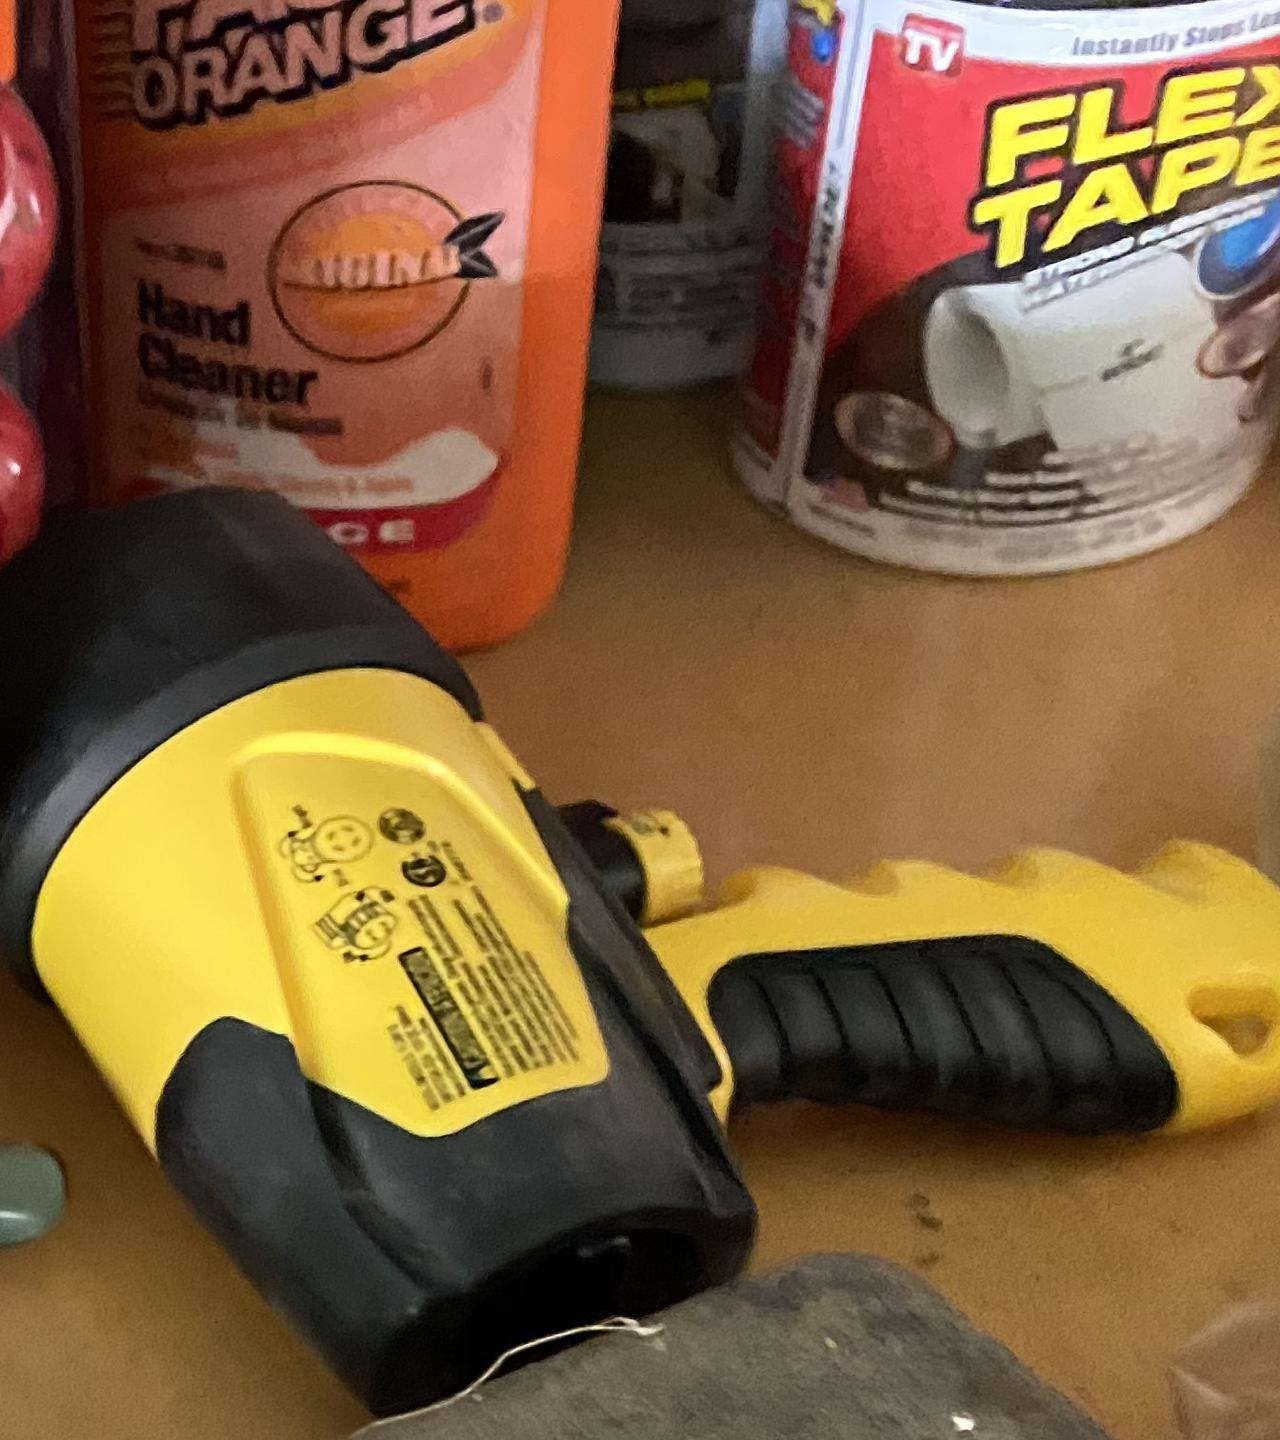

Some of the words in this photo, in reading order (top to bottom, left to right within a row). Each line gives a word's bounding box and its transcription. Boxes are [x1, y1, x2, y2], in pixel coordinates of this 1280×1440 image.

[131, 0, 471, 124] ORANGE
[903, 27, 960, 72] TV
[1070, 32, 1180, 57] Instantly
[1183, 19, 1247, 48] Stops
[138, 277, 251, 348] Hand
[139, 332, 319, 404] Cleaner
